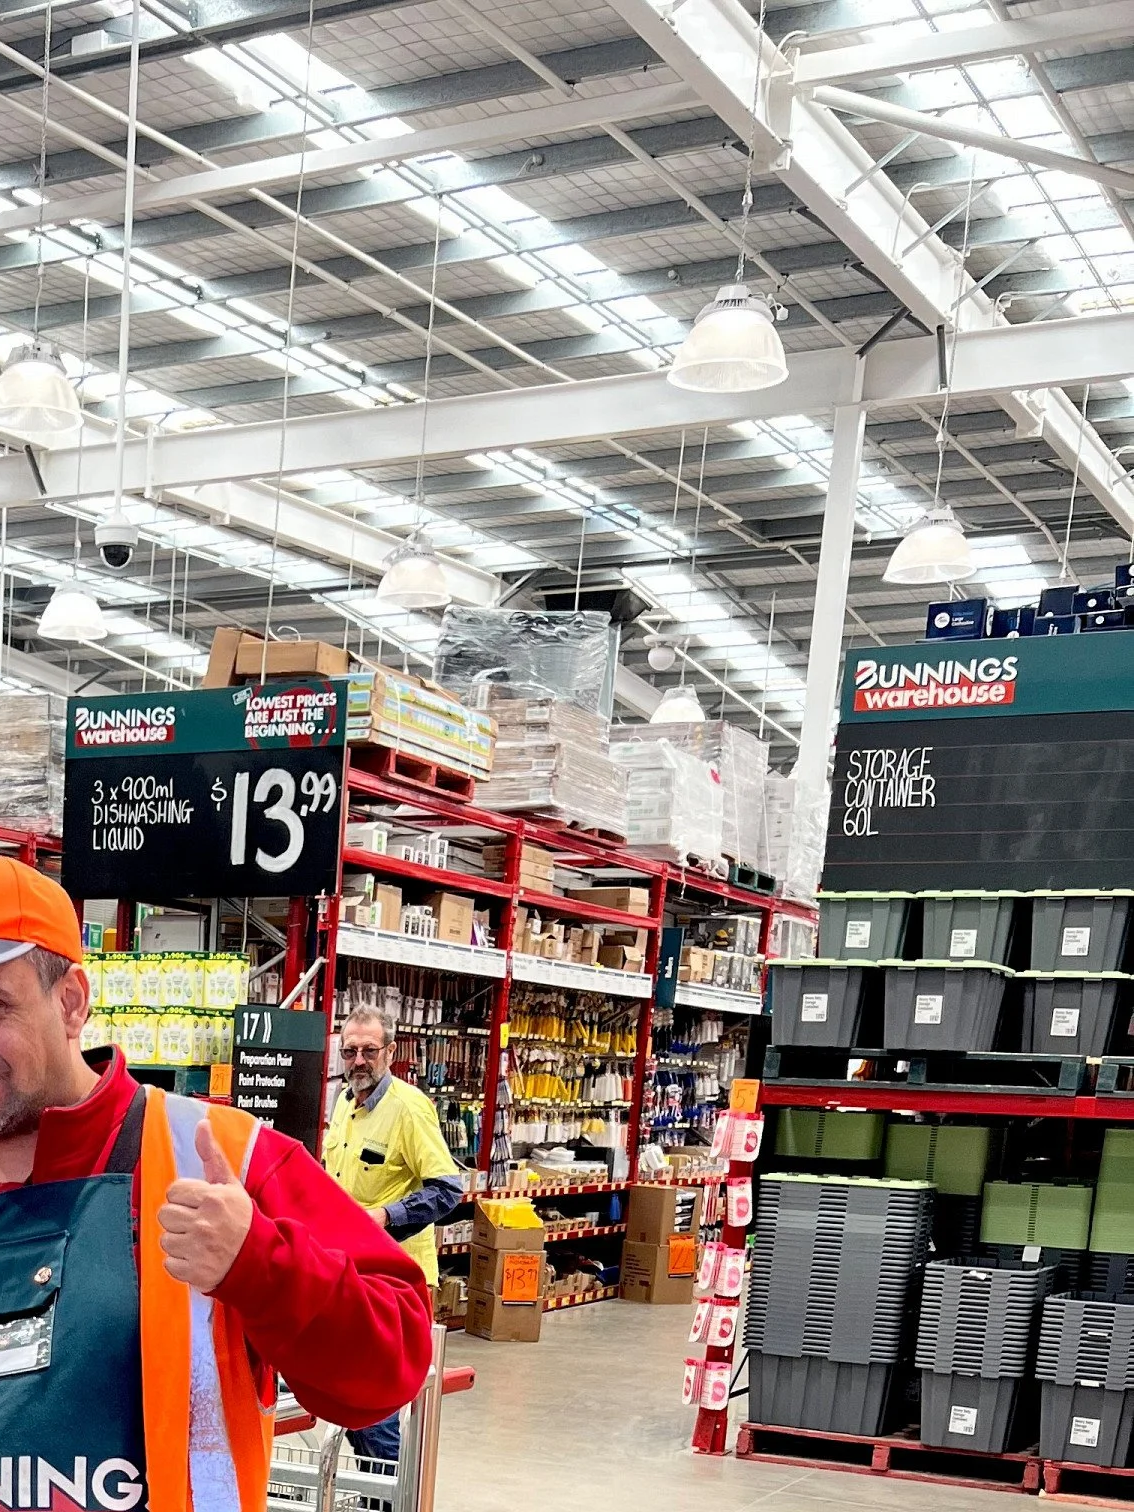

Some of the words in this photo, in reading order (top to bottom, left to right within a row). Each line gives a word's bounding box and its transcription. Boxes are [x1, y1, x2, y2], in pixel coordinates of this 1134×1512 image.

[855, 657, 1018, 689] BUNNINGS
[246, 695, 294, 710] LOWEST
[297, 692, 337, 706] PRICES
[864, 682, 1005, 710] warehouse
[75, 706, 175, 730] BUNNINGS
[245, 710, 268, 724] ARE
[270, 709, 300, 723] JUST
[301, 708, 324, 721] THE
[80, 727, 168, 745] warehouse
[847, 747, 933, 781] STORAGE
[91, 780, 104, 804] 3
[845, 777, 936, 808] CONTAINER
[93, 799, 194, 825] DISHWASHING
[843, 808, 879, 837] 60L
[93, 826, 144, 851] LIQUID
[243, 1012, 260, 1040] 17
[240, 1051, 276, 1067] Preparation
[277, 1053, 293, 1066] Paint
[238, 1073, 254, 1086] Paint
[255, 1073, 285, 1087] Protection
[237, 1094, 253, 1108] Paint
[254, 1095, 278, 1108] Brushes
